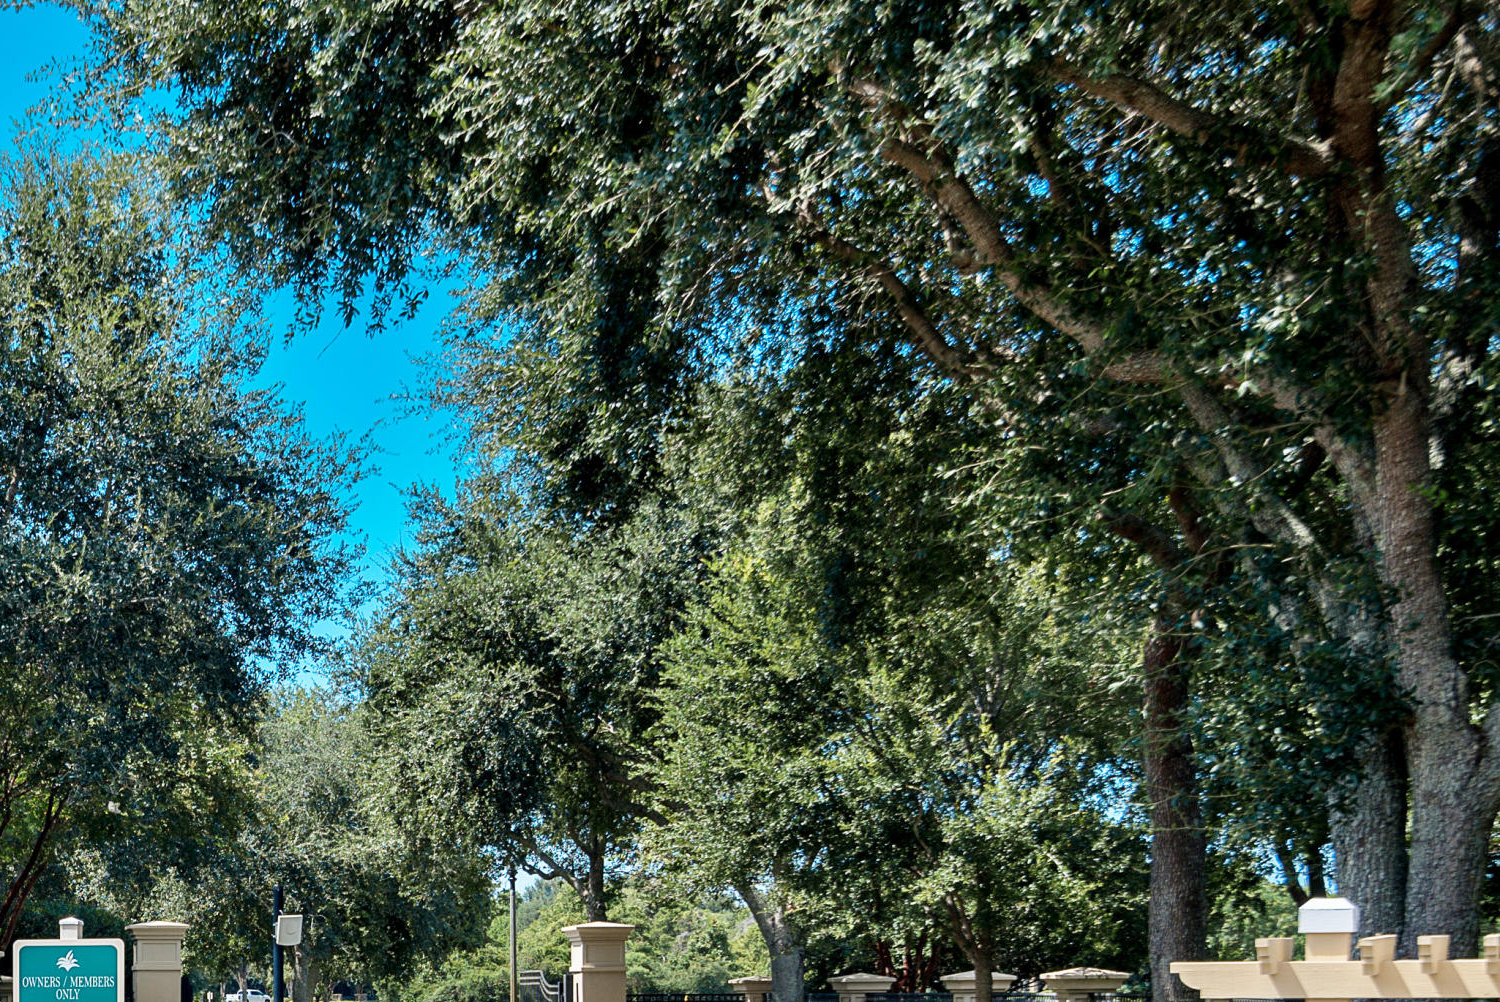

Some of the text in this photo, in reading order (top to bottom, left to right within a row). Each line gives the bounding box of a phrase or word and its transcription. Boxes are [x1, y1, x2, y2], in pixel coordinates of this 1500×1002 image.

[22, 976, 60, 988] OWNERS
[70, 976, 115, 988] MEMBERS
[55, 988, 80, 1000] ONLY
